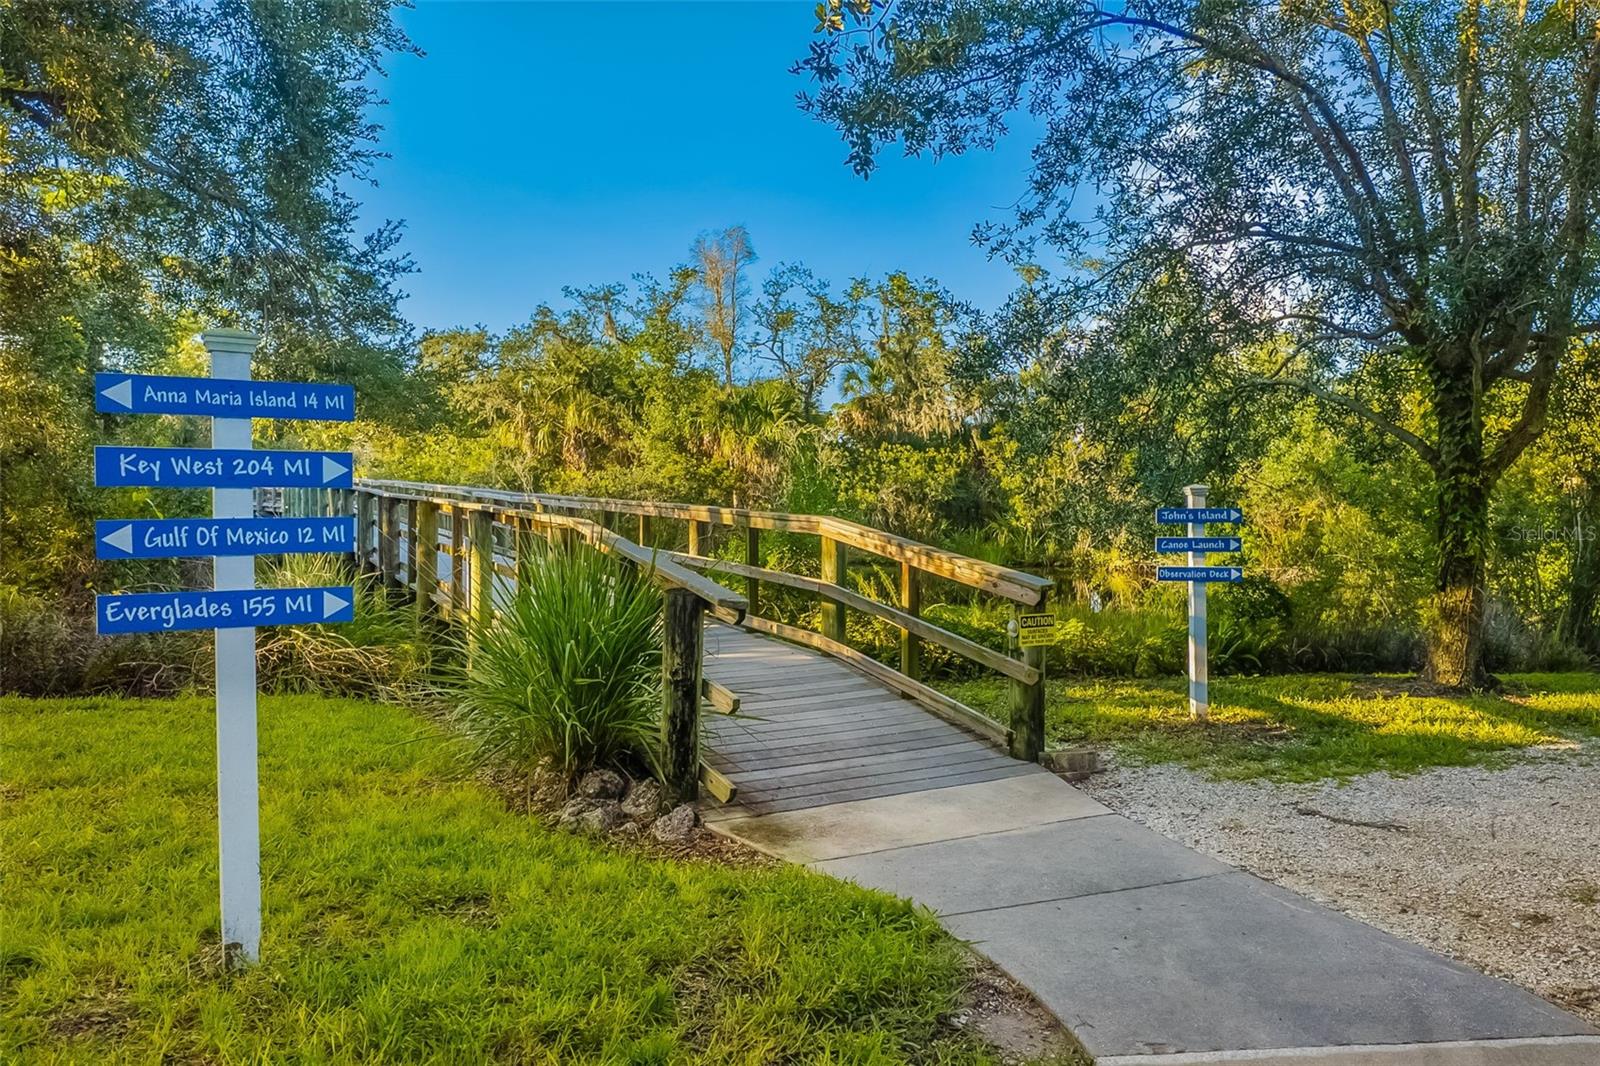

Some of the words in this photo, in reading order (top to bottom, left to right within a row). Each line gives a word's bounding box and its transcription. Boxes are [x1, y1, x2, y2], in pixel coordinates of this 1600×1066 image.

[144, 385, 187, 403] Anna
[196, 389, 242, 406] Maria
[250, 391, 296, 408] Island
[304, 395, 318, 409] 14
[325, 395, 345, 409] MI
[119, 454, 161, 481] Key
[171, 456, 223, 475] West
[233, 456, 274, 475] 204
[284, 459, 310, 476] MI
[1161, 511, 1194, 520] John's
[1198, 511, 1227, 519] Island
[144, 526, 189, 548] Gulf
[196, 525, 218, 546] Of
[227, 528, 289, 545] Mexico
[298, 527, 315, 543] 12
[323, 526, 345, 542] MI
[1161, 540, 1189, 549] Canoe
[1159, 570, 1206, 578] Observation
[106, 597, 231, 627] Everglades
[243, 596, 275, 617] 155
[286, 595, 312, 613] MI
[1022, 616, 1053, 627] CAUTION
